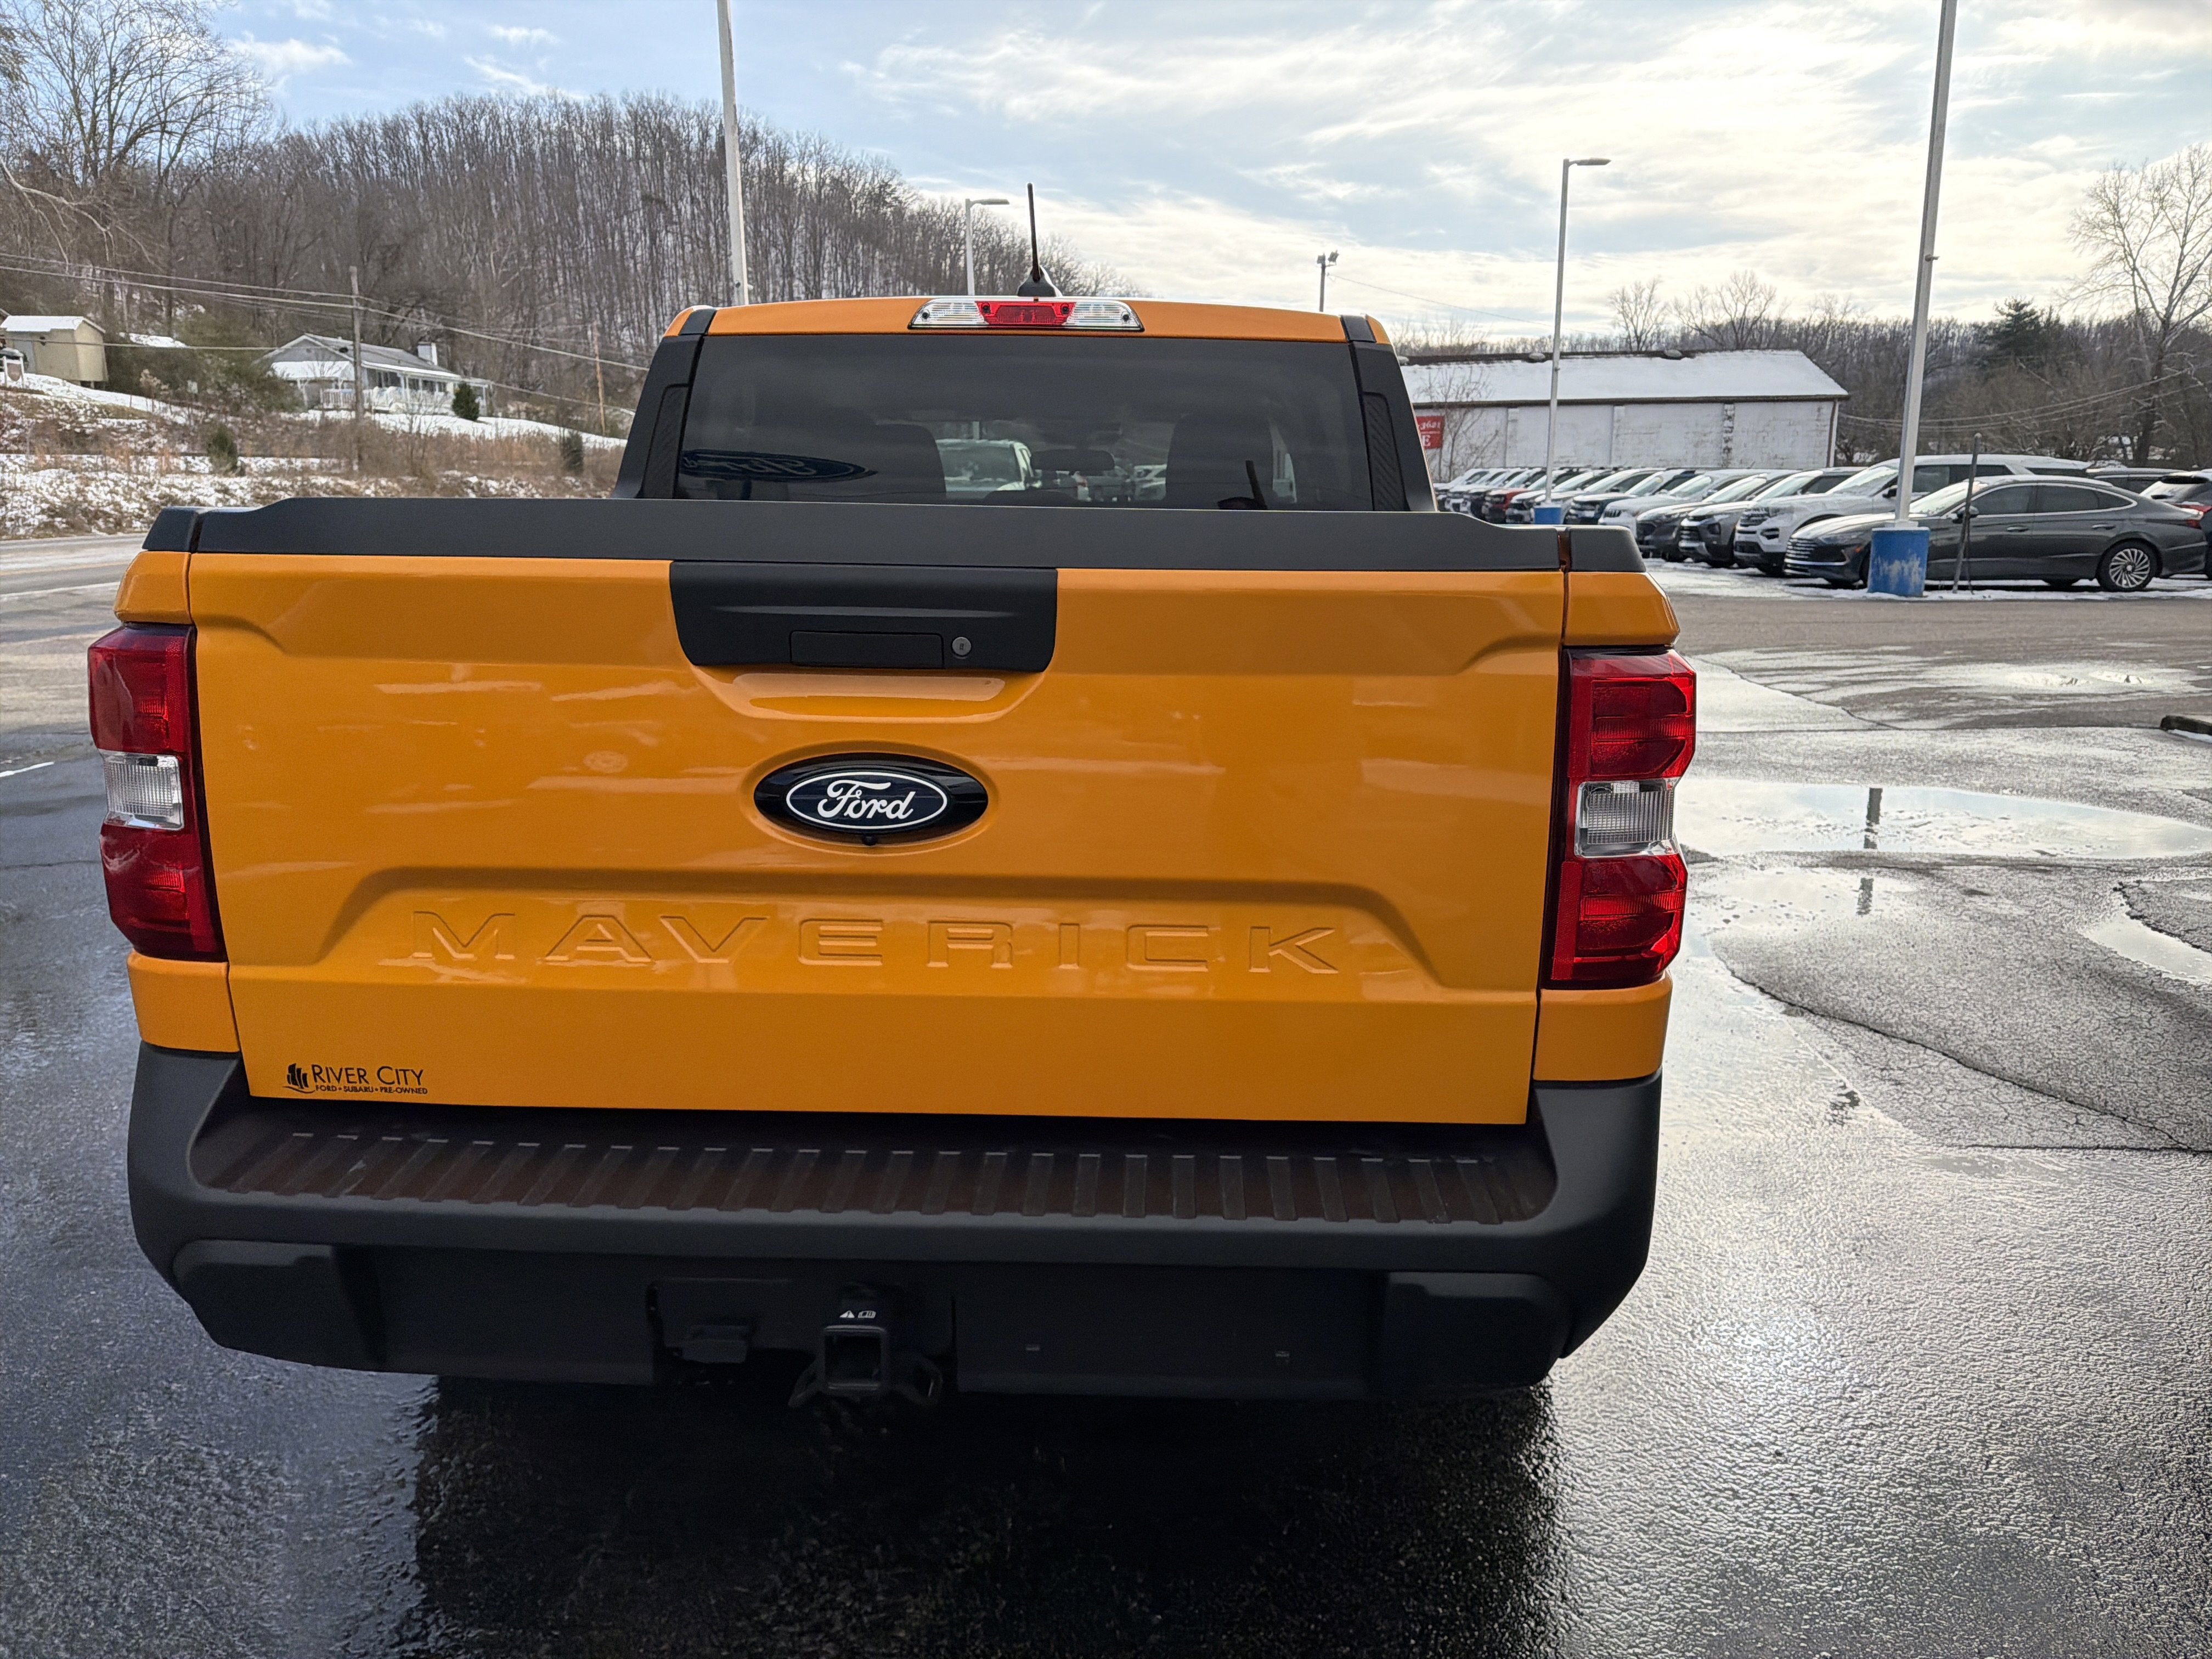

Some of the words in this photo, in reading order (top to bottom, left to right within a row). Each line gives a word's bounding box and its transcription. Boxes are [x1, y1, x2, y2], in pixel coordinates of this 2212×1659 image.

[817, 779, 917, 820] Ford
[412, 911, 1339, 974] MAVERICK
[311, 1064, 370, 1085] RIVER
[376, 1065, 424, 1086] CITY
[380, 1087, 428, 1095] PRE-OWNED
